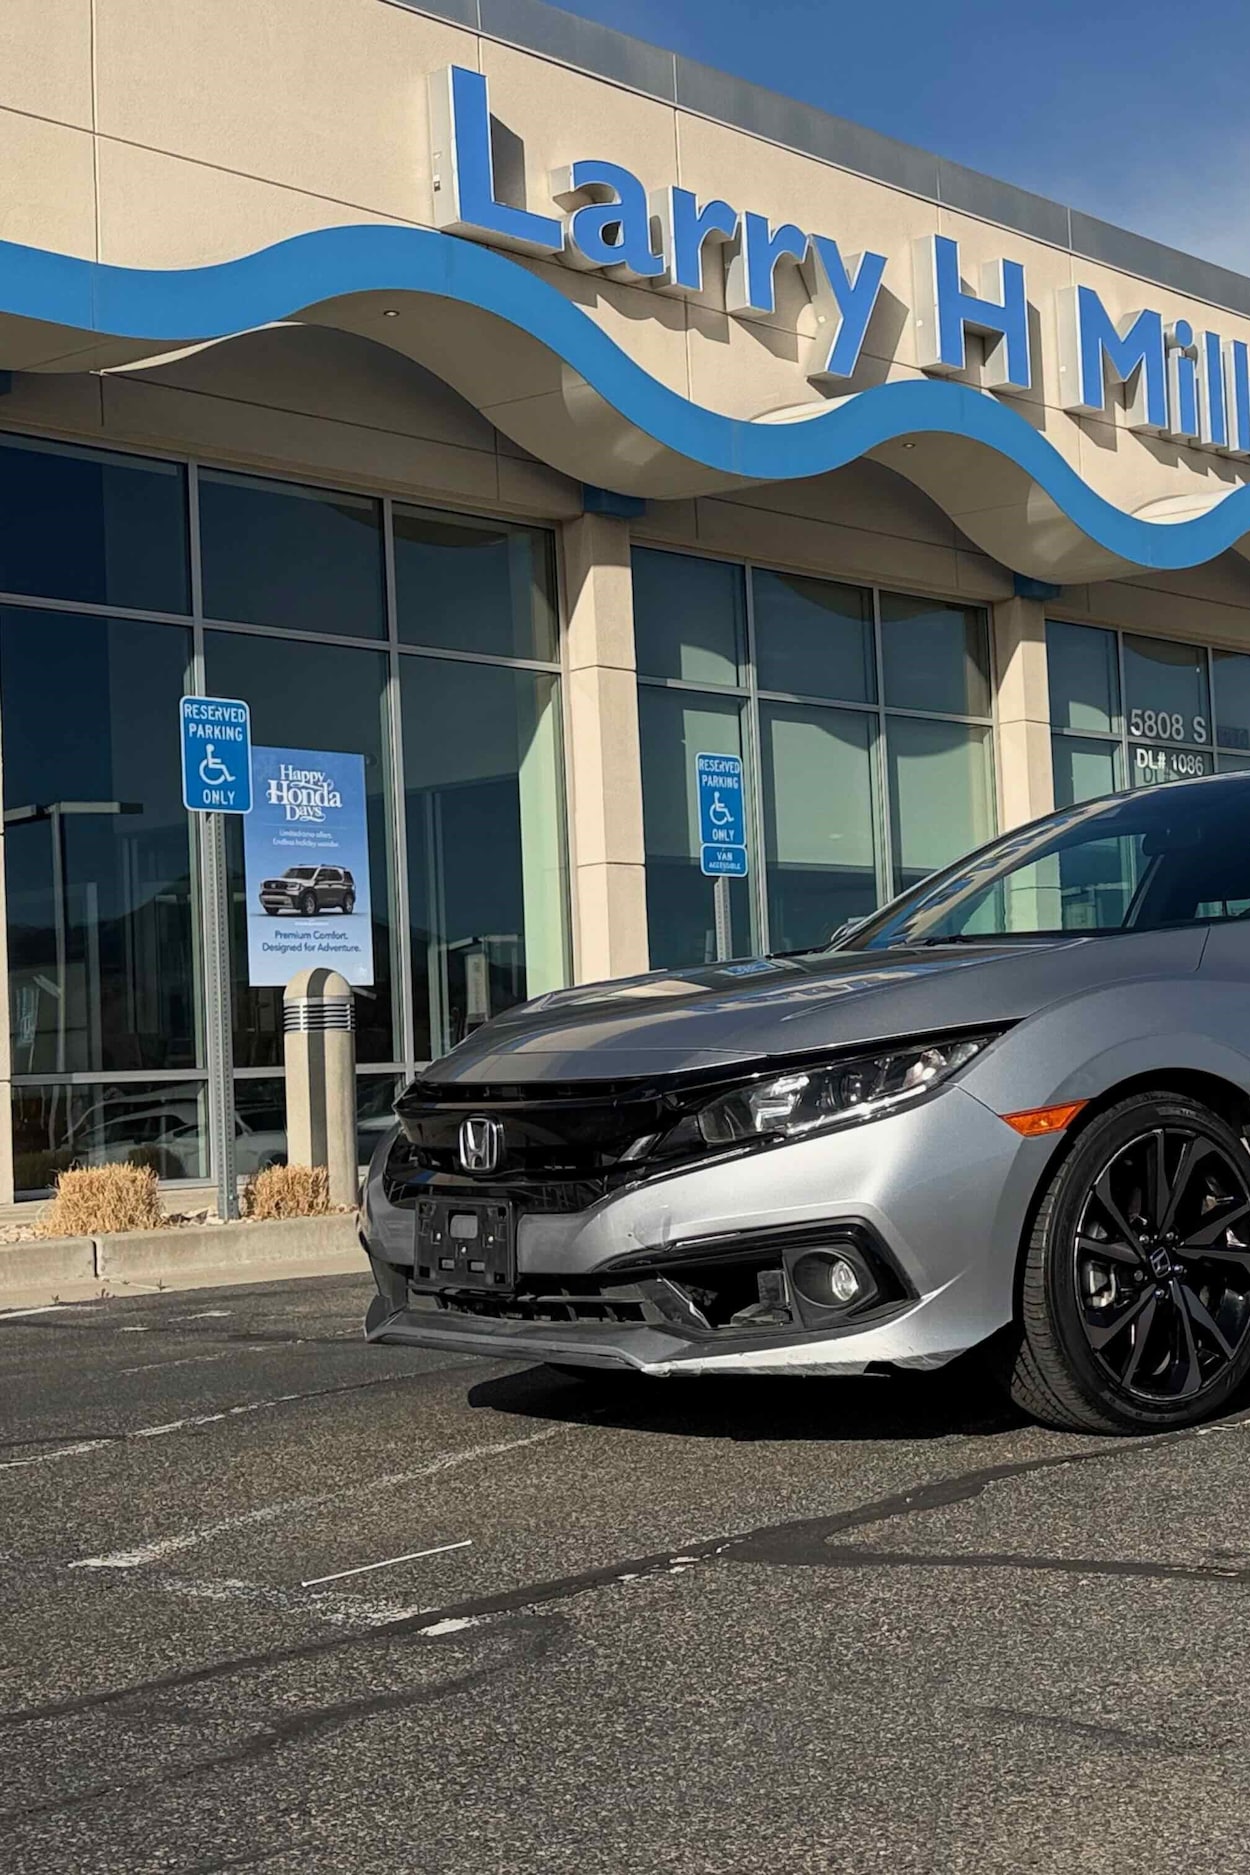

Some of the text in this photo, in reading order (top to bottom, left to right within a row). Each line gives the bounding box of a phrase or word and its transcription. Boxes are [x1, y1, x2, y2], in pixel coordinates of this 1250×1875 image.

[445, 65, 886, 380] Larry
[926, 234, 1031, 391] H
[184, 703, 247, 723] RESERVED
[188, 723, 243, 742] PARKING
[1130, 709, 1207, 743] 5808 S
[698, 758, 740, 774] RESERVED
[1136, 748, 1167, 769] DL#
[1171, 754, 1204, 776] 1086
[280, 764, 327, 789] Happy
[702, 774, 739, 789] PARKING
[203, 789, 236, 805] ONLY
[265, 779, 343, 808] Honda
[286, 804, 327, 822] Days
[712, 828, 735, 841] ONLY
[716, 851, 733, 861] VAN
[275, 929, 311, 940] Premium
[262, 942, 302, 954] Designed
[304, 942, 315, 952] for
